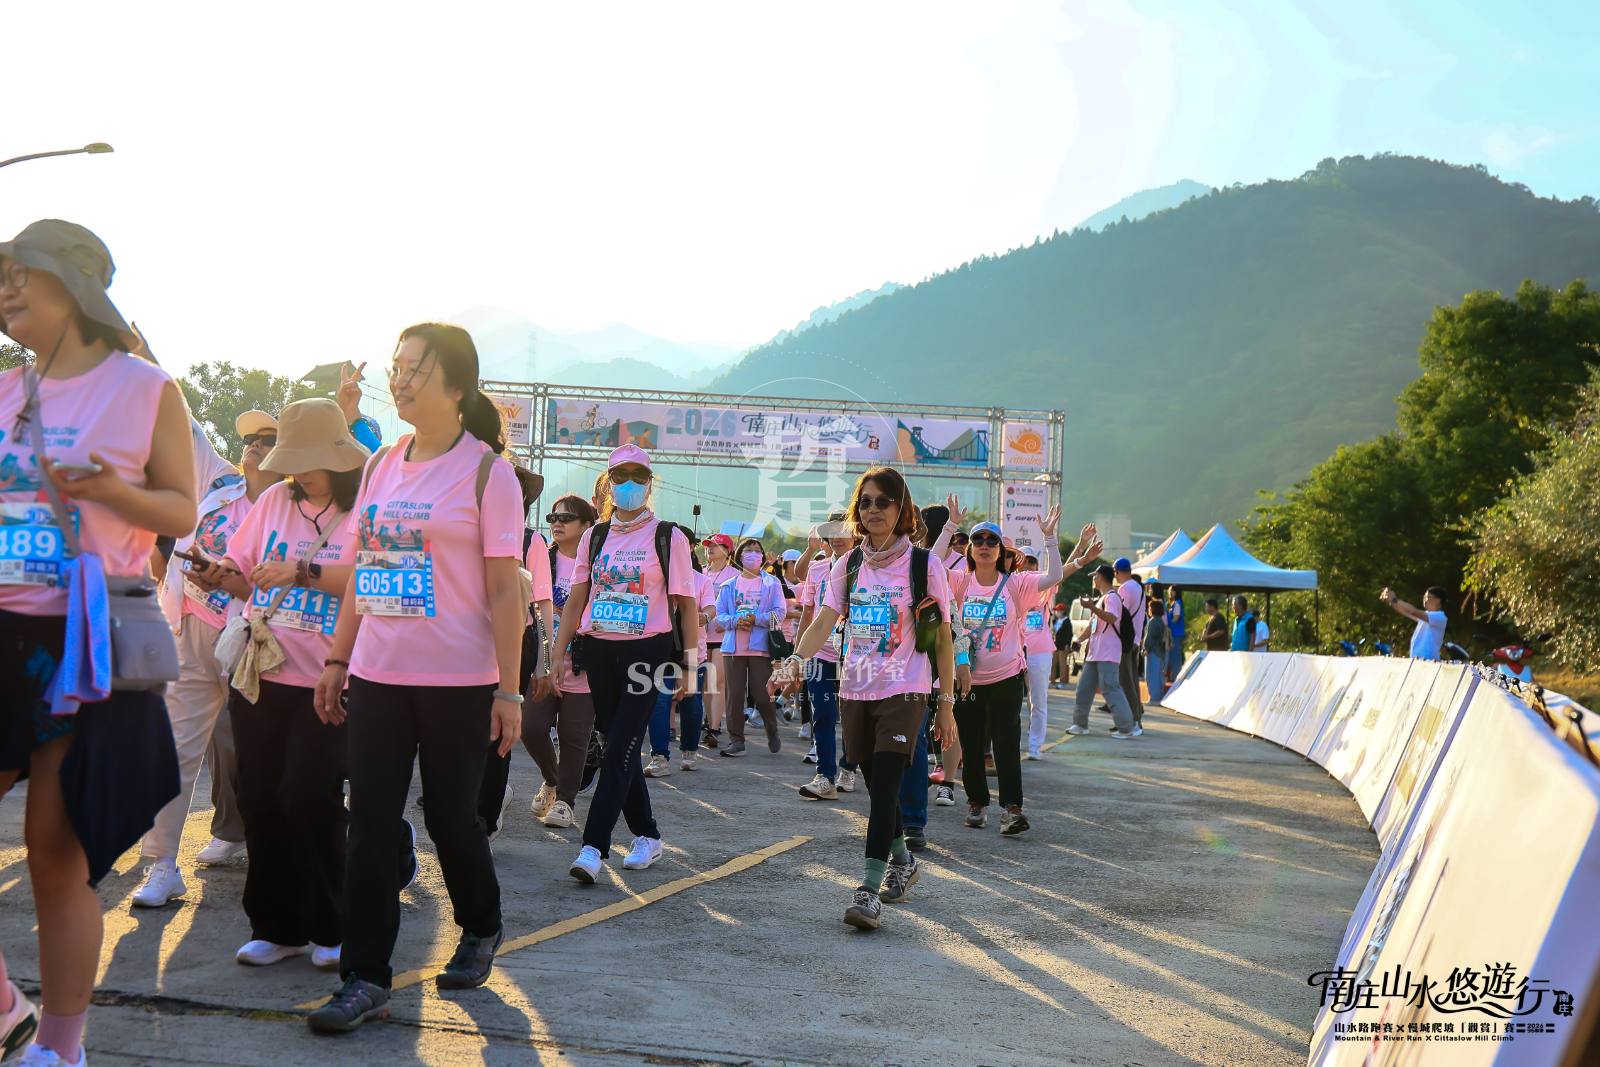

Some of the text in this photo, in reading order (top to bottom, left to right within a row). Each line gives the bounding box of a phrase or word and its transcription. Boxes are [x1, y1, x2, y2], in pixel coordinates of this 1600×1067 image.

[665, 407, 738, 438] 2026
[387, 501, 433, 510] CITTASLOW
[383, 511, 430, 520] HILL CLIMB
[358, 571, 423, 595] 60513
[593, 604, 644, 622] 60441
